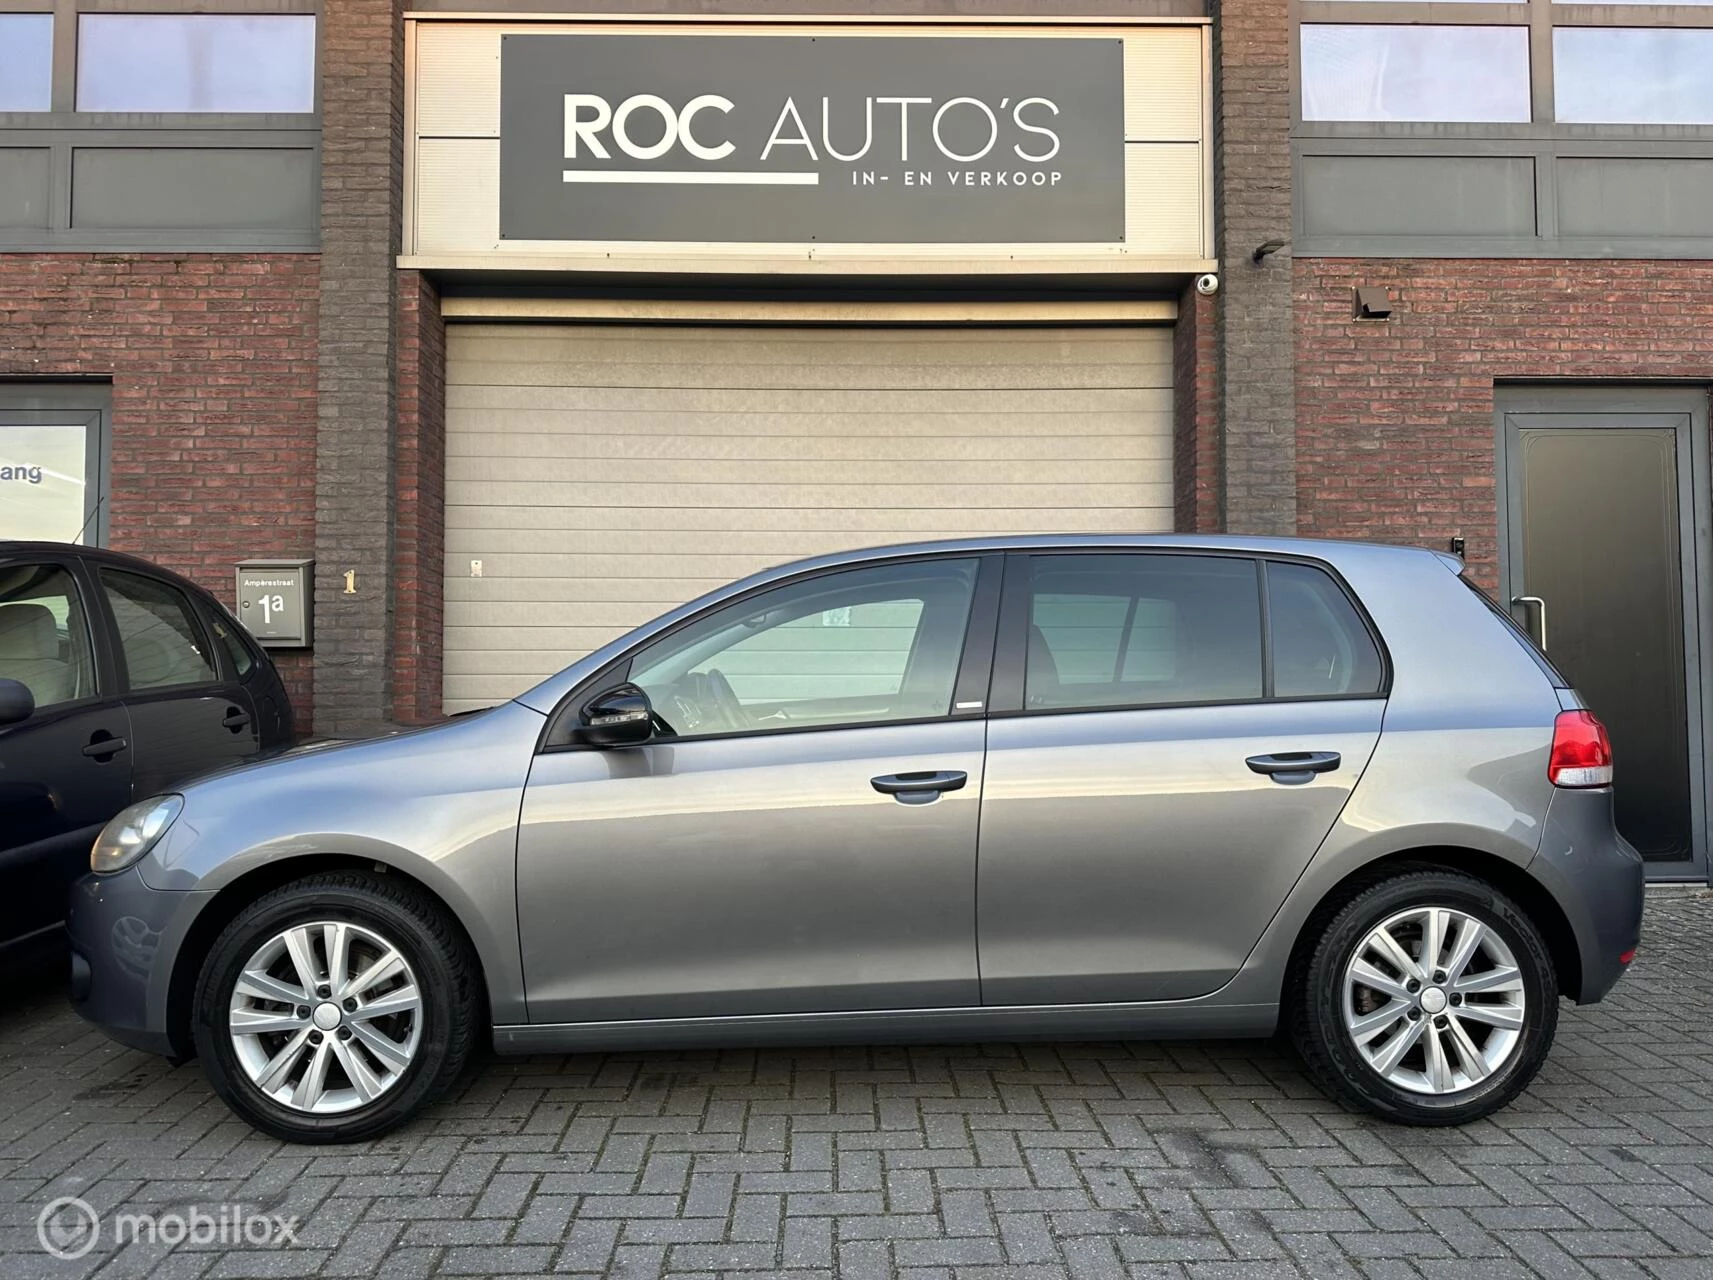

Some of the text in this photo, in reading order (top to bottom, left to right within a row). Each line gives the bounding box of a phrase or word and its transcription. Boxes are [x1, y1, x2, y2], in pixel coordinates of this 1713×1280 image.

[564, 94, 1060, 162] ROC AUTO'S
[852, 171, 1062, 186] IN- EN VERKOOP
[343, 569, 357, 593] 1
[258, 594, 284, 623] 1a
